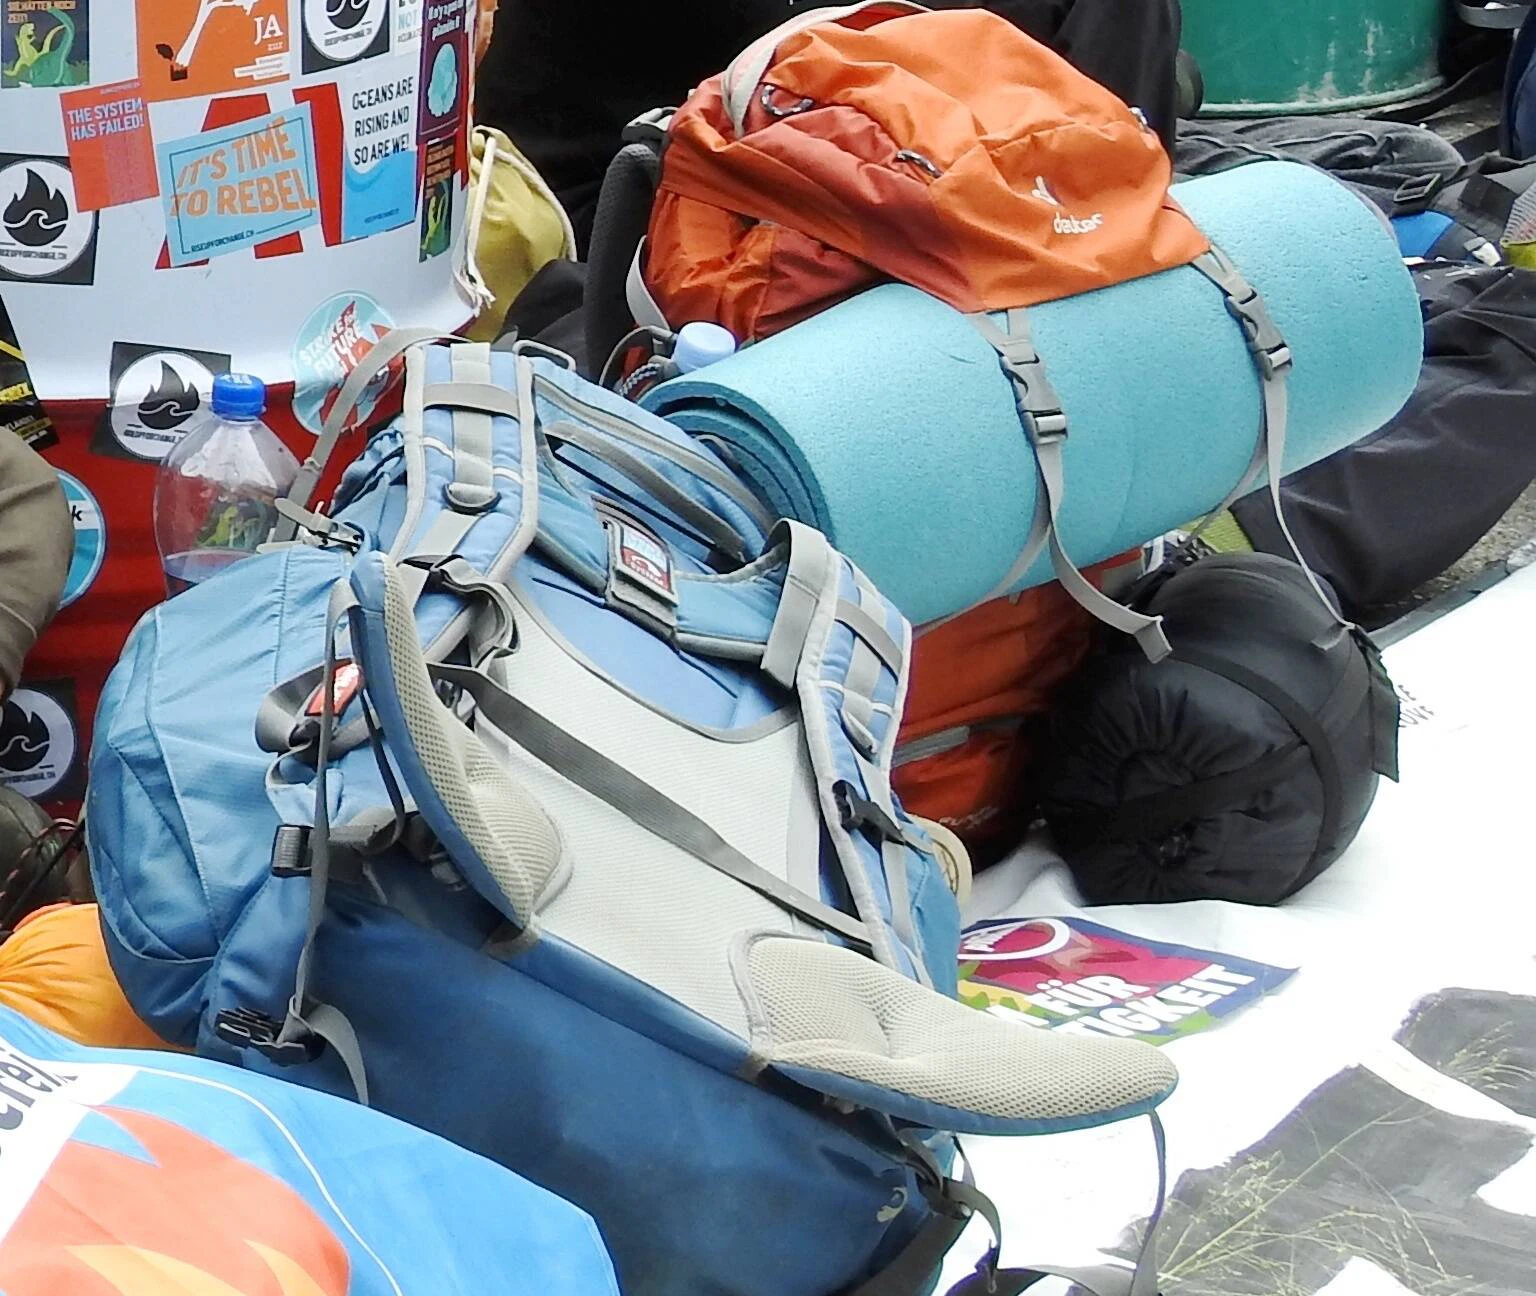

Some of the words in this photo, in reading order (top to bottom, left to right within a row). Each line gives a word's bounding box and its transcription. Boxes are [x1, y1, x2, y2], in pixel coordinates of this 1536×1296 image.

[253, 14, 285, 45] JA
[351, 82, 394, 111] OCEANS
[395, 76, 415, 99] ARE
[67, 108, 94, 126] THE
[94, 97, 144, 119] SYSTEM
[353, 114, 390, 138] RISING
[390, 111, 411, 130] AND
[71, 123, 97, 142] HAS
[98, 115, 145, 137] FAILED!
[178, 147, 228, 189] IT'S
[231, 115, 297, 174] TIME
[353, 148, 369, 166] SO
[369, 142, 391, 163] ARE
[392, 139, 410, 155] WE!
[169, 189, 211, 218] TO
[215, 167, 318, 216] REBEL
[1029, 973, 1152, 1016] FÜR
